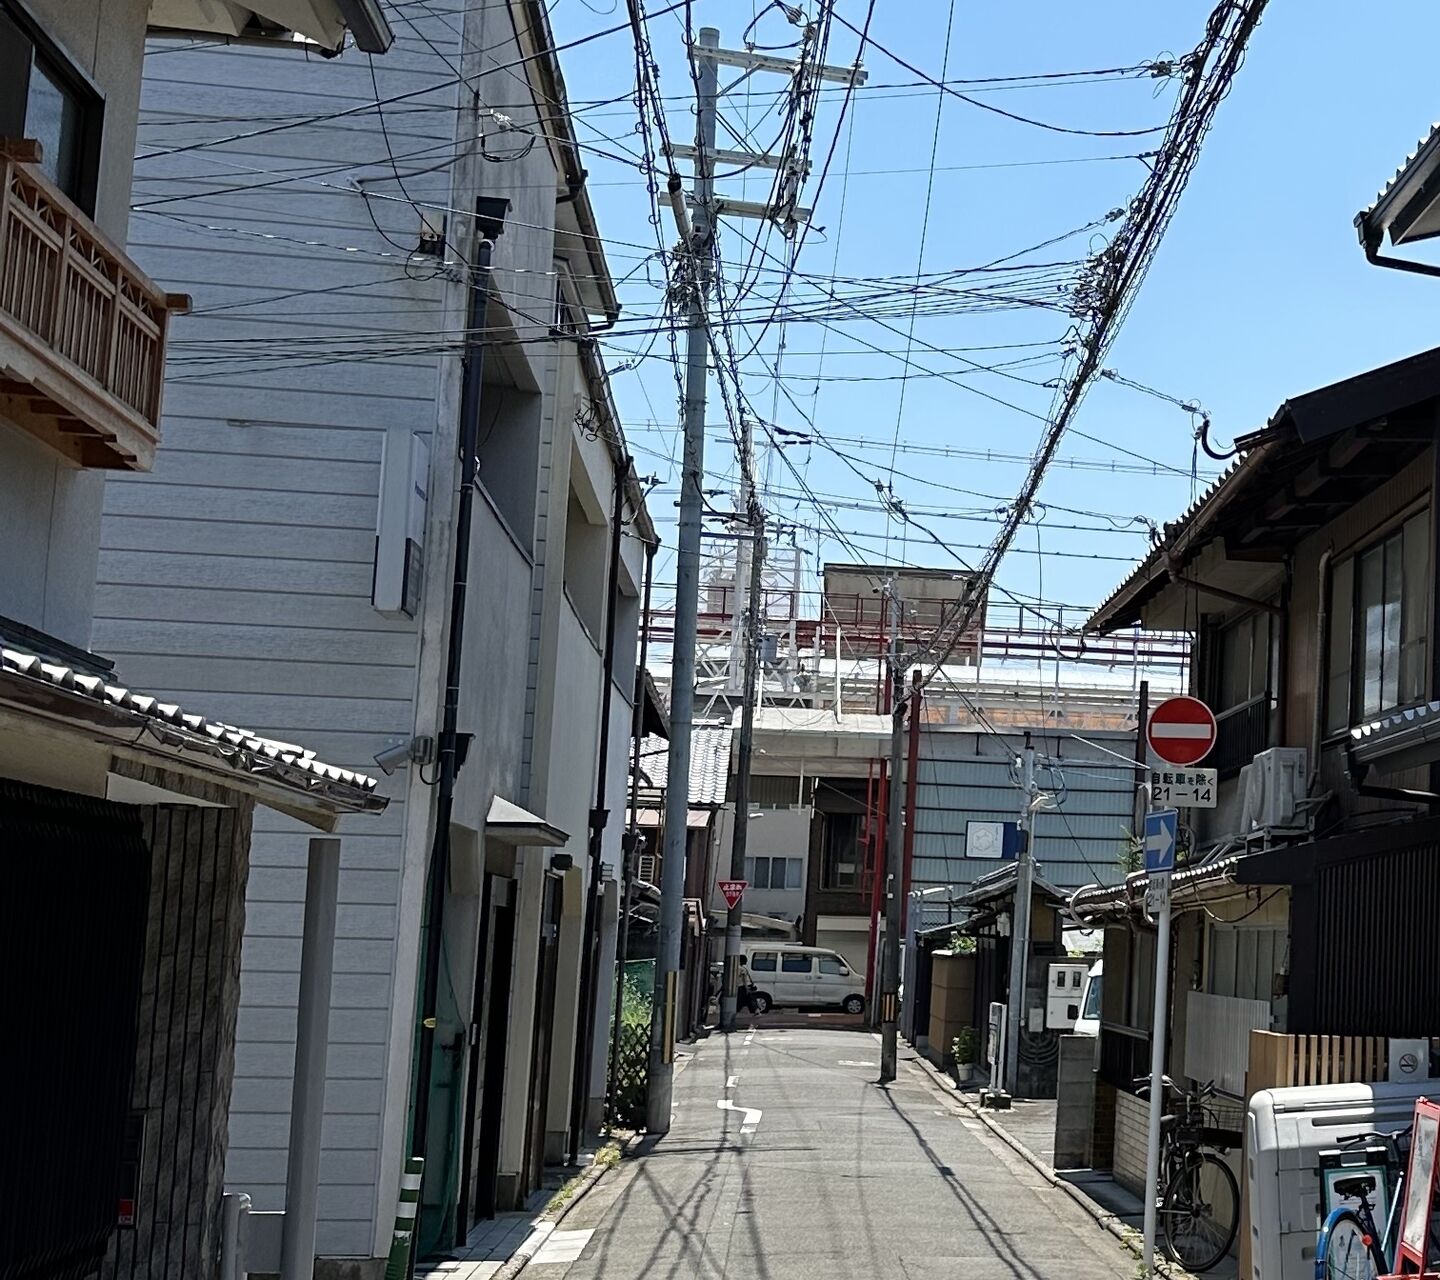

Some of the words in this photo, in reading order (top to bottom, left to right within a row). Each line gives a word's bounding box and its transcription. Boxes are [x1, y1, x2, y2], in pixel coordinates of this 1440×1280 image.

[1152, 772, 1214, 786] 自転車を除く
